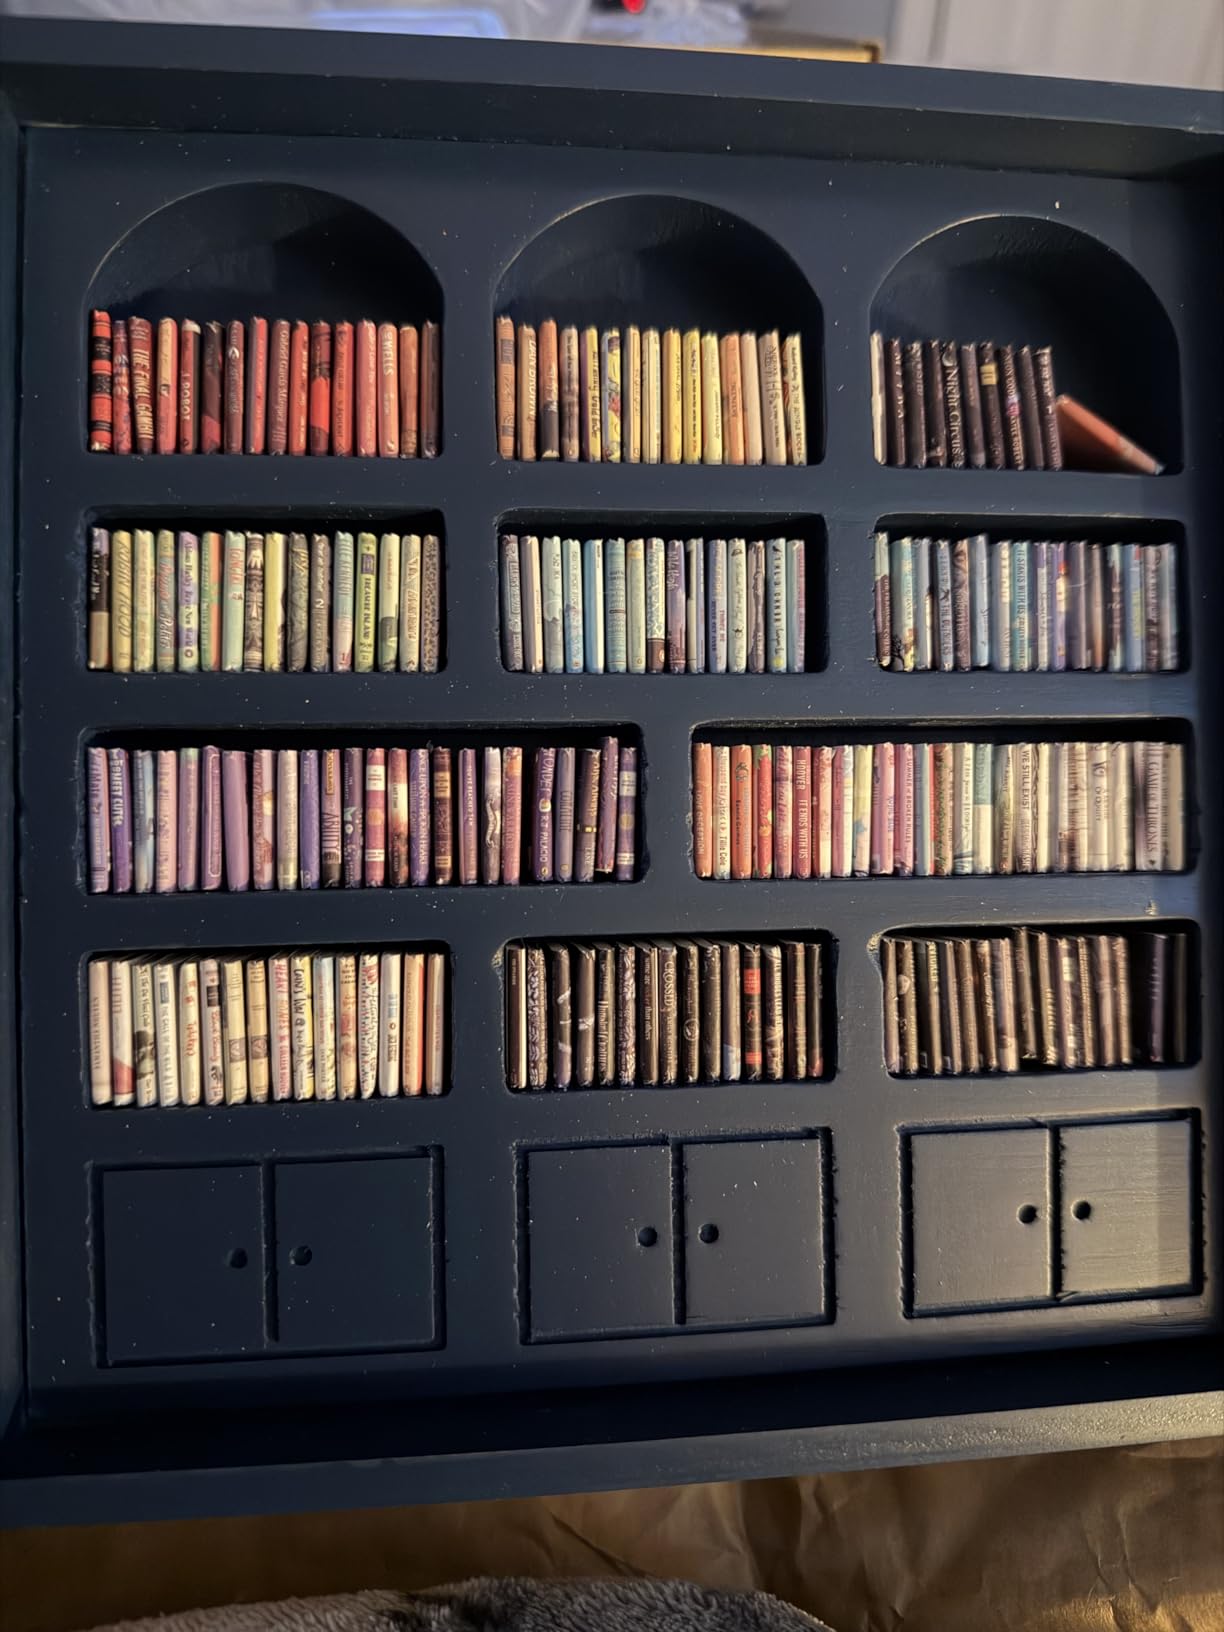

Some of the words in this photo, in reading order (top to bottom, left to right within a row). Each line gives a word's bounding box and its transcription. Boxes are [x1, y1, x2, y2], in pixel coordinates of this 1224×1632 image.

[132, 349, 150, 369] THE
[134, 370, 151, 400] FINAL
[945, 368, 961, 405] Night
[136, 403, 154, 440] GAMBIT
[950, 411, 965, 456] Circus
[118, 541, 131, 587] ROBIN
[118, 591, 131, 638] HOOD
[1022, 750, 1031, 763] WE
[112, 772, 124, 797] MEET
[796, 759, 806, 791] HOOVER
[1022, 764, 1031, 786] STILL
[1021, 787, 1031, 811] EXIST
[799, 807, 808, 827] ENDS
[539, 831, 550, 863] PALACIO
[799, 827, 808, 848] WITH
[799, 848, 808, 860] US
[663, 960, 676, 1007] CROSSED
[644, 1006, 652, 1019] than
[644, 1020, 653, 1040] others
